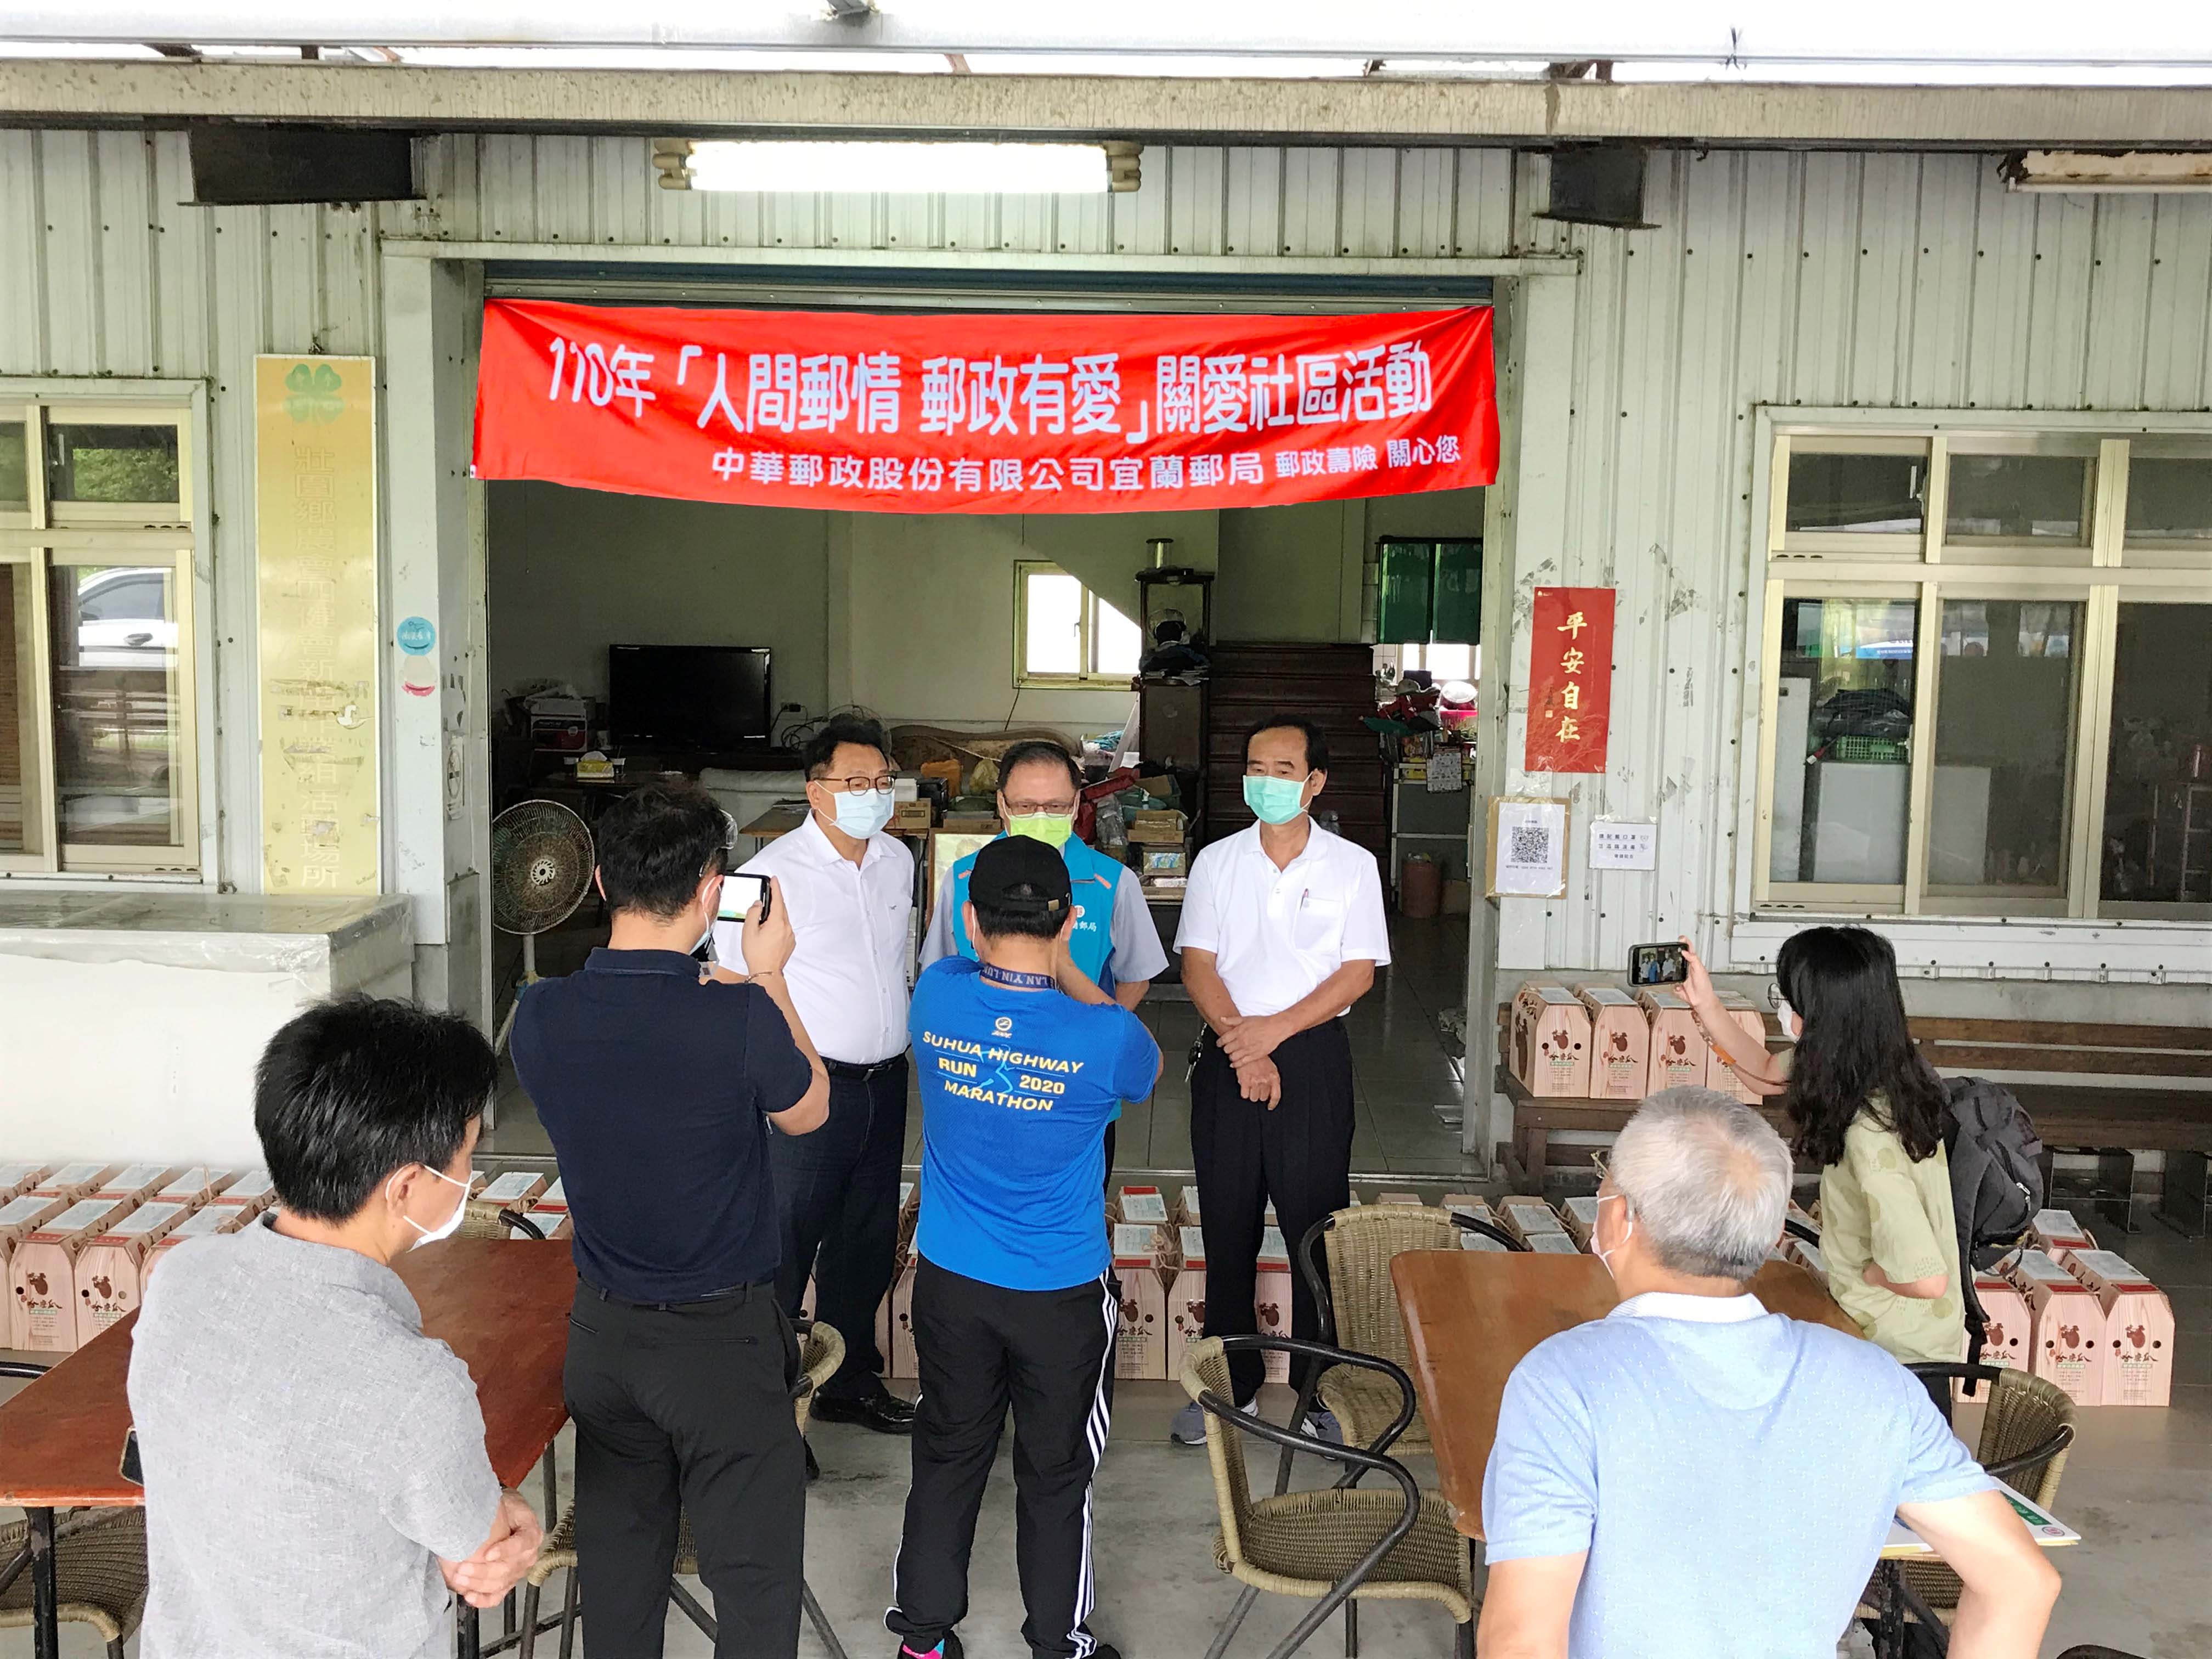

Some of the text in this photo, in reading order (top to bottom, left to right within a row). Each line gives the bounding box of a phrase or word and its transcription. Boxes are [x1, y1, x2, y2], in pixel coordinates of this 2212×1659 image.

[712, 435, 1461, 494] 中華郵政股份有限公司宜蘭郵局 郵政壽險 關心您
[1555, 611, 1588, 743] 平安自在
[922, 1031, 1084, 1074] SUHUA HIGHWAY
[938, 1057, 1065, 1095] RUN 2020
[944, 1080, 1054, 1111] MARATHON
